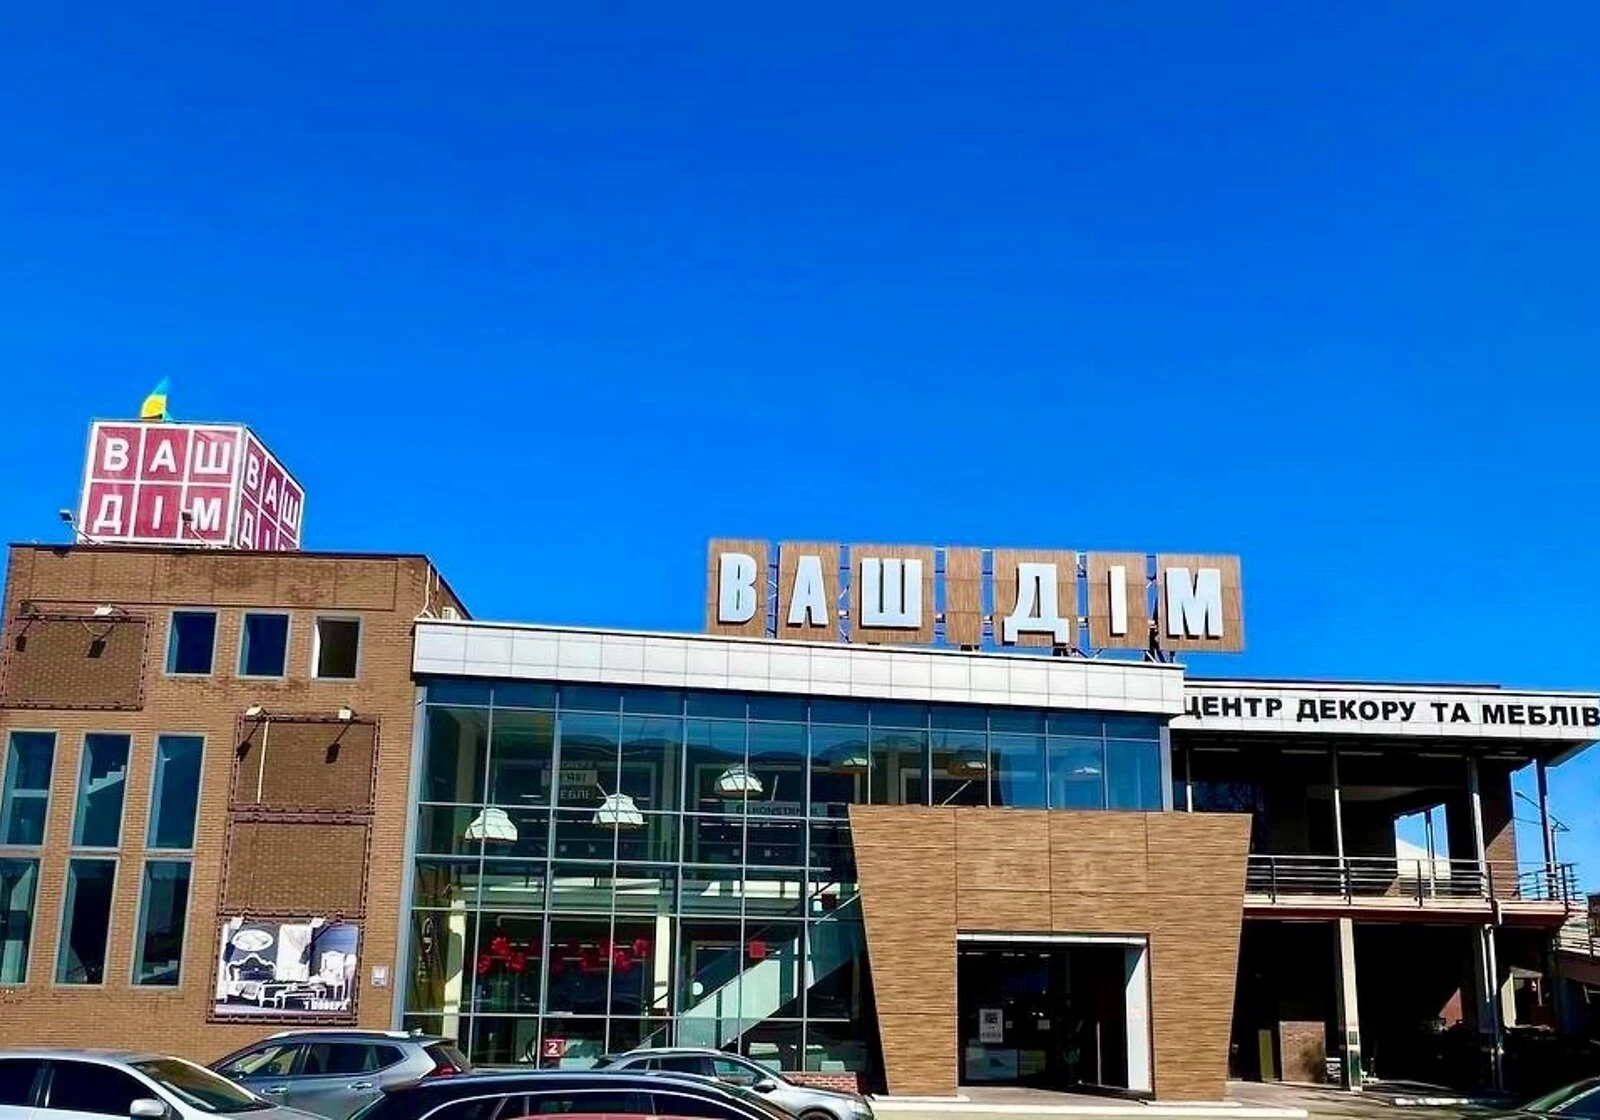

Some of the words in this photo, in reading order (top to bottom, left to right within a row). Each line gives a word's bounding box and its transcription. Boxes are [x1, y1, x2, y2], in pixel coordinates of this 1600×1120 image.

[103, 437, 231, 475] ВАШ
[246, 452, 299, 531] ВАШ
[93, 494, 222, 535] ДІМ
[240, 508, 288, 551] ДІ
[718, 552, 922, 630] ВАШ
[1003, 563, 1224, 645] ДІМ
[1184, 696, 1283, 719] ЦЕНТР
[1296, 699, 1416, 722] ДЕКОРУ
[1430, 703, 1471, 722] ТА
[1482, 704, 1600, 726] МЕБЛІВ
[548, 1042, 558, 1054] 2
